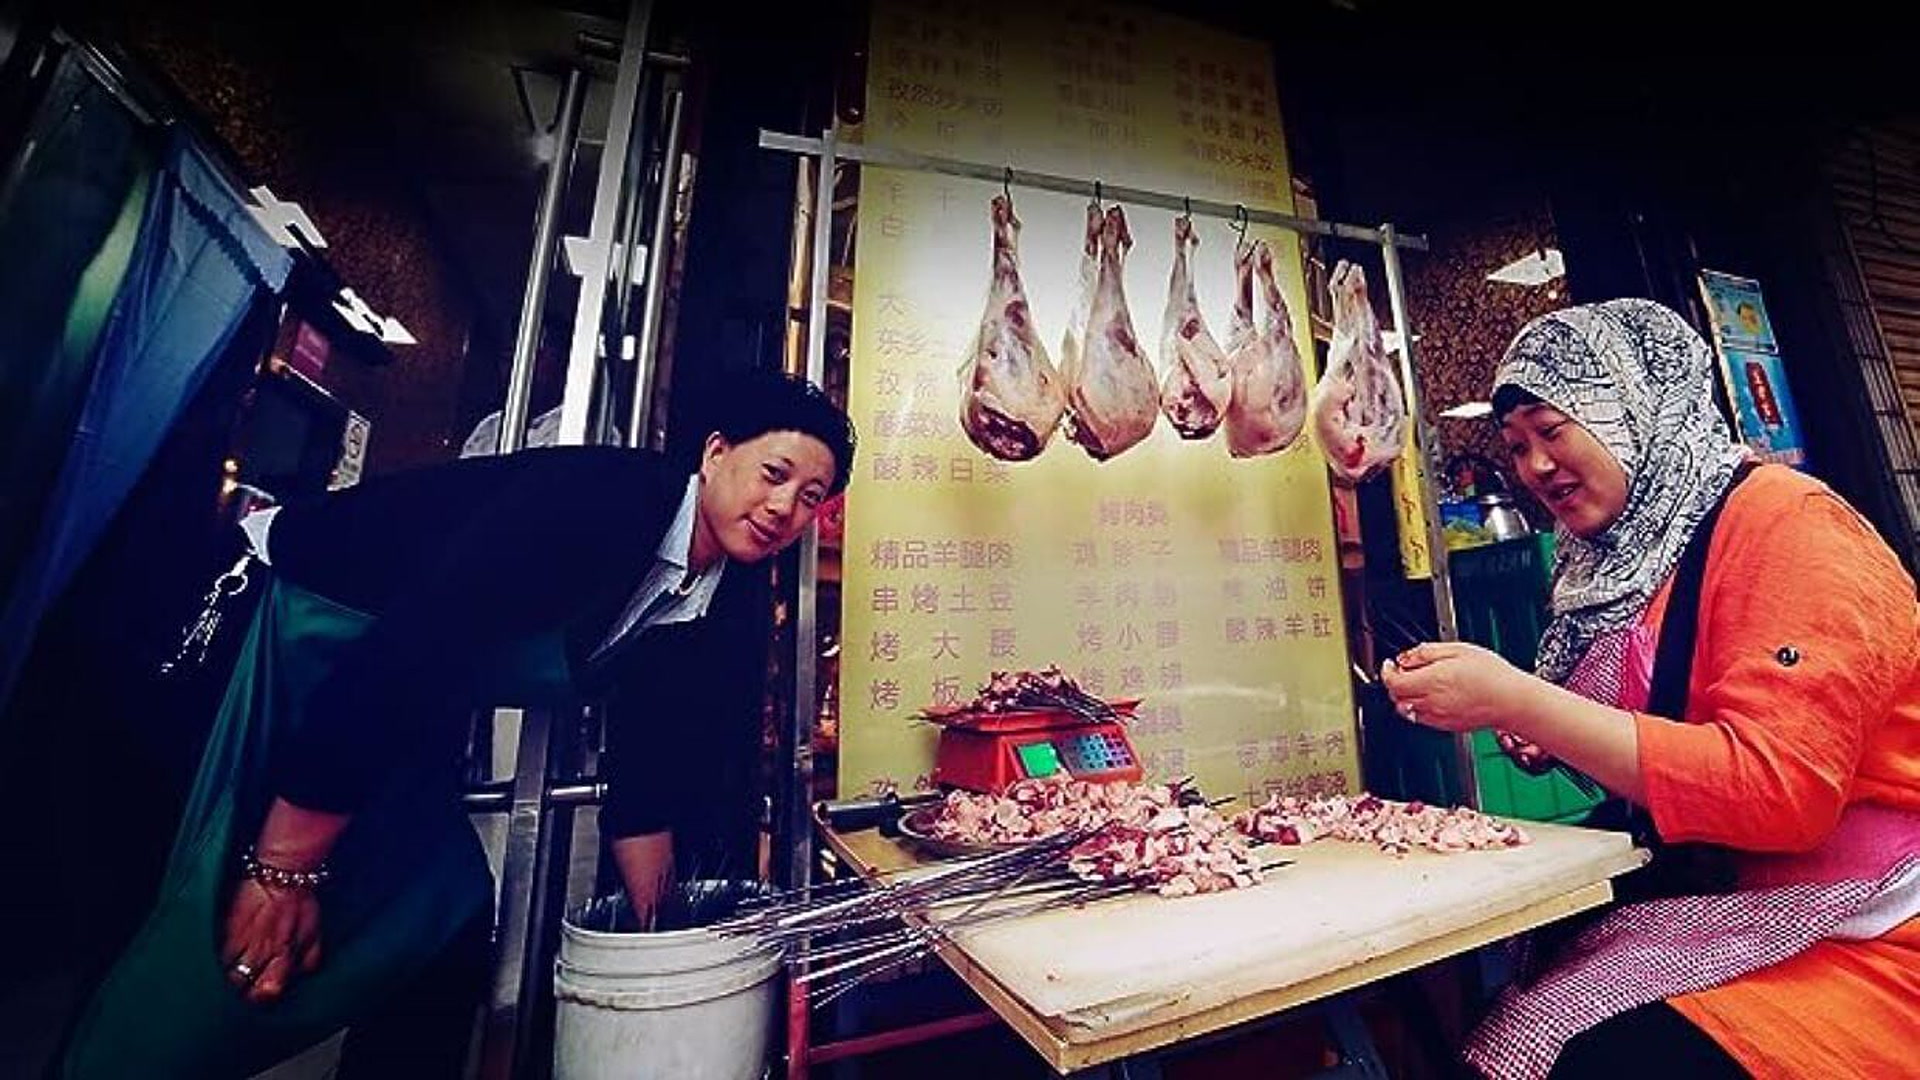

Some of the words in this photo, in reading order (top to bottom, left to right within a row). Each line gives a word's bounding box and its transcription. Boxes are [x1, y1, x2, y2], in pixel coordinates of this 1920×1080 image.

[869, 540, 1012, 570] 精品羊腿肉
[872, 583, 1013, 615] 串烤土豆
